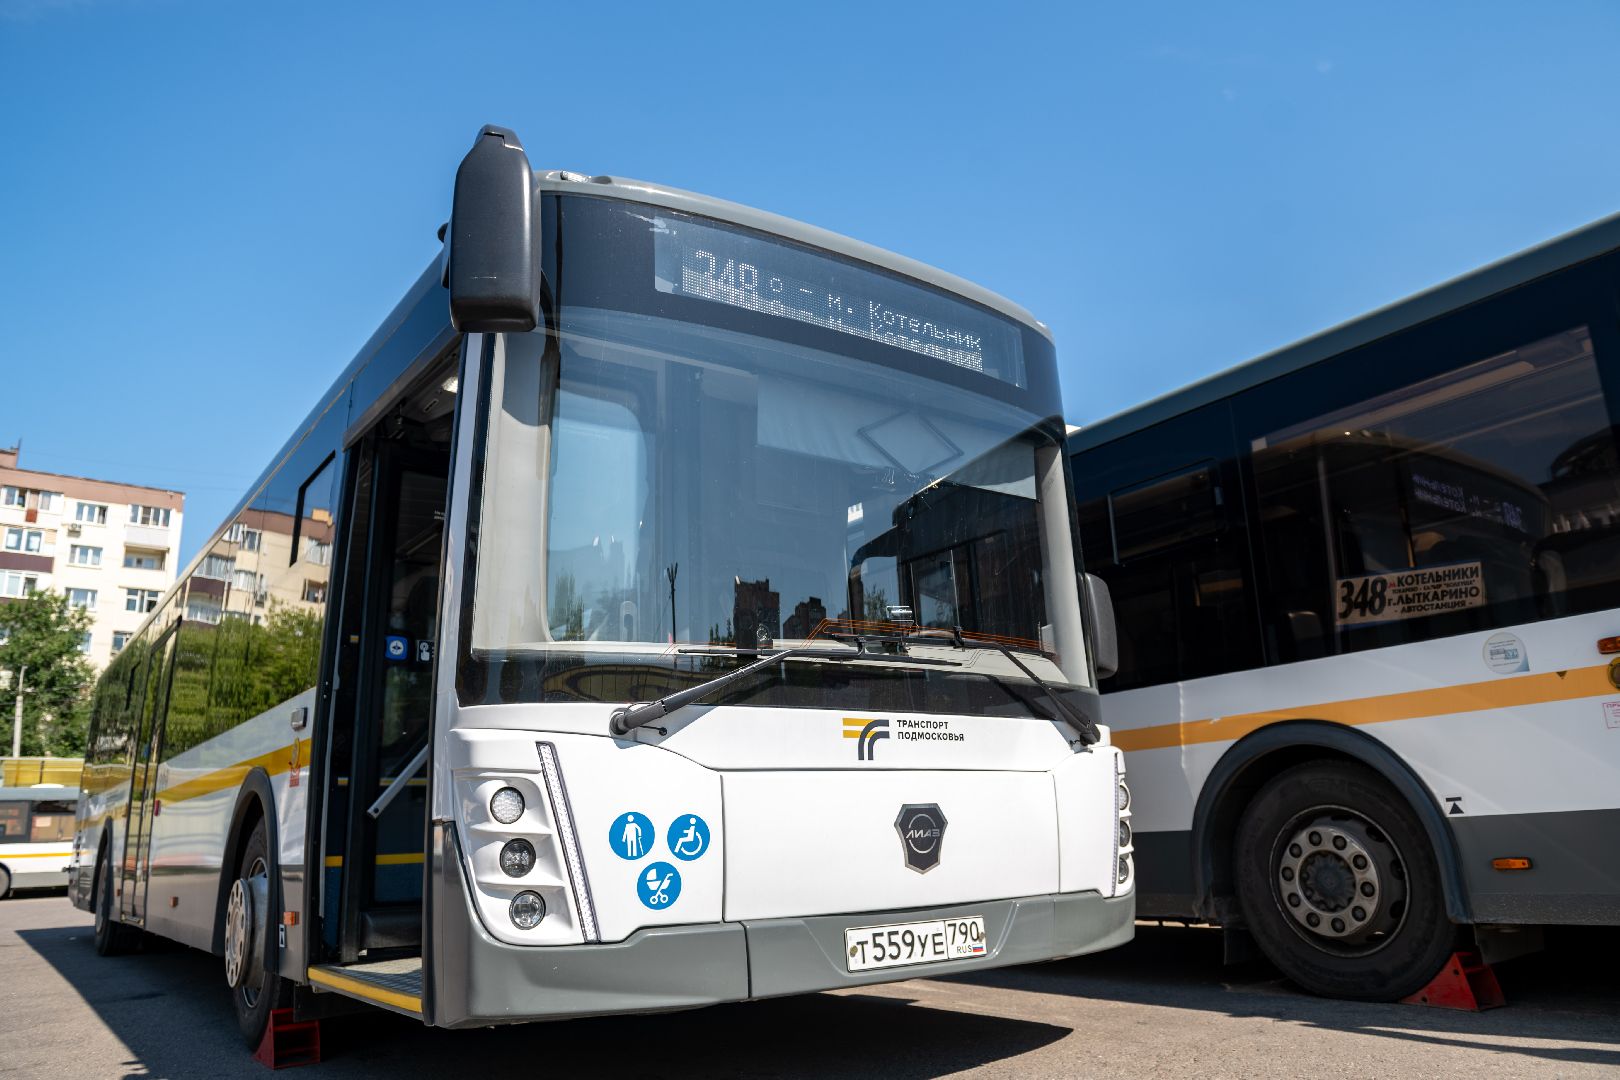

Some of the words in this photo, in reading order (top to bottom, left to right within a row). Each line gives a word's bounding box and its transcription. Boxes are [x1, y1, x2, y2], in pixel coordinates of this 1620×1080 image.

[1337, 576, 1388, 619] 348
[1401, 600, 1466, 614] АВТОСТАНЦИЯ
[897, 719, 949, 729] ТРАНСПОРТ
[897, 731, 965, 741] ПОДМОСКОВЬЯ
[905, 828, 941, 839] ЛИАЗ
[856, 929, 945, 964] Т559УЕ
[947, 921, 980, 946] 790
[956, 944, 972, 954] RUS
